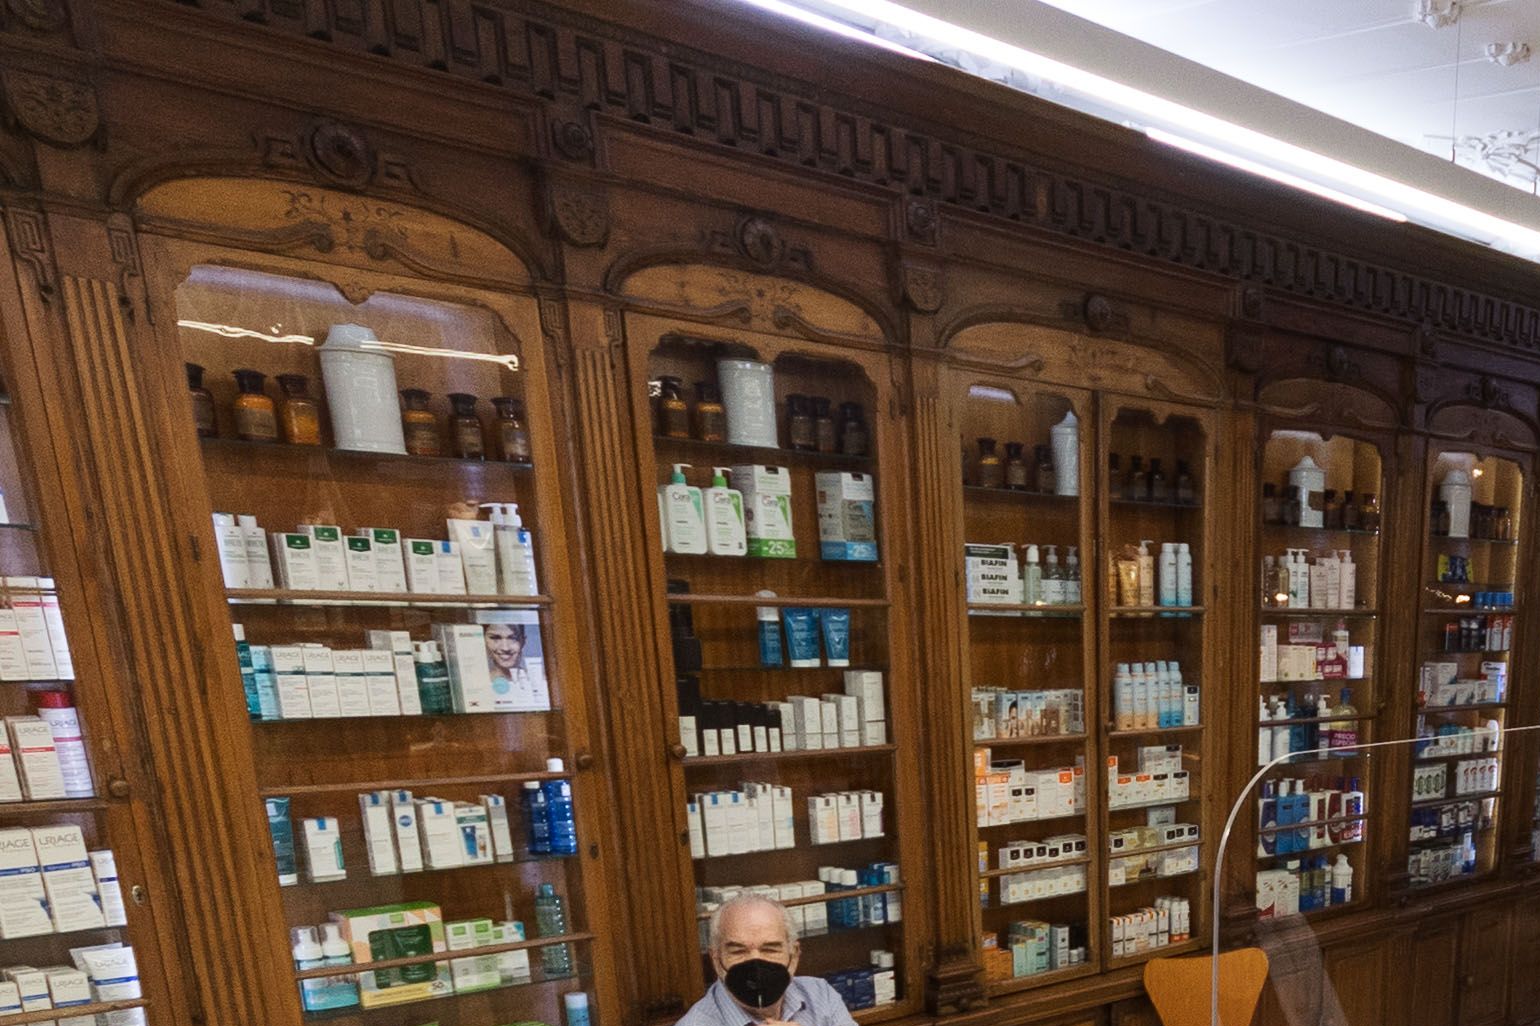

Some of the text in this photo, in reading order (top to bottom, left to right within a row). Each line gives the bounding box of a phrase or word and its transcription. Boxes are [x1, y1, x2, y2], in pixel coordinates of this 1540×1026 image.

[981, 559, 1007, 568] BIAFIN
[981, 573, 1008, 582] BIAFIN
[982, 587, 1009, 596] BIAFIN
[39, 832, 80, 847] URIAGE
